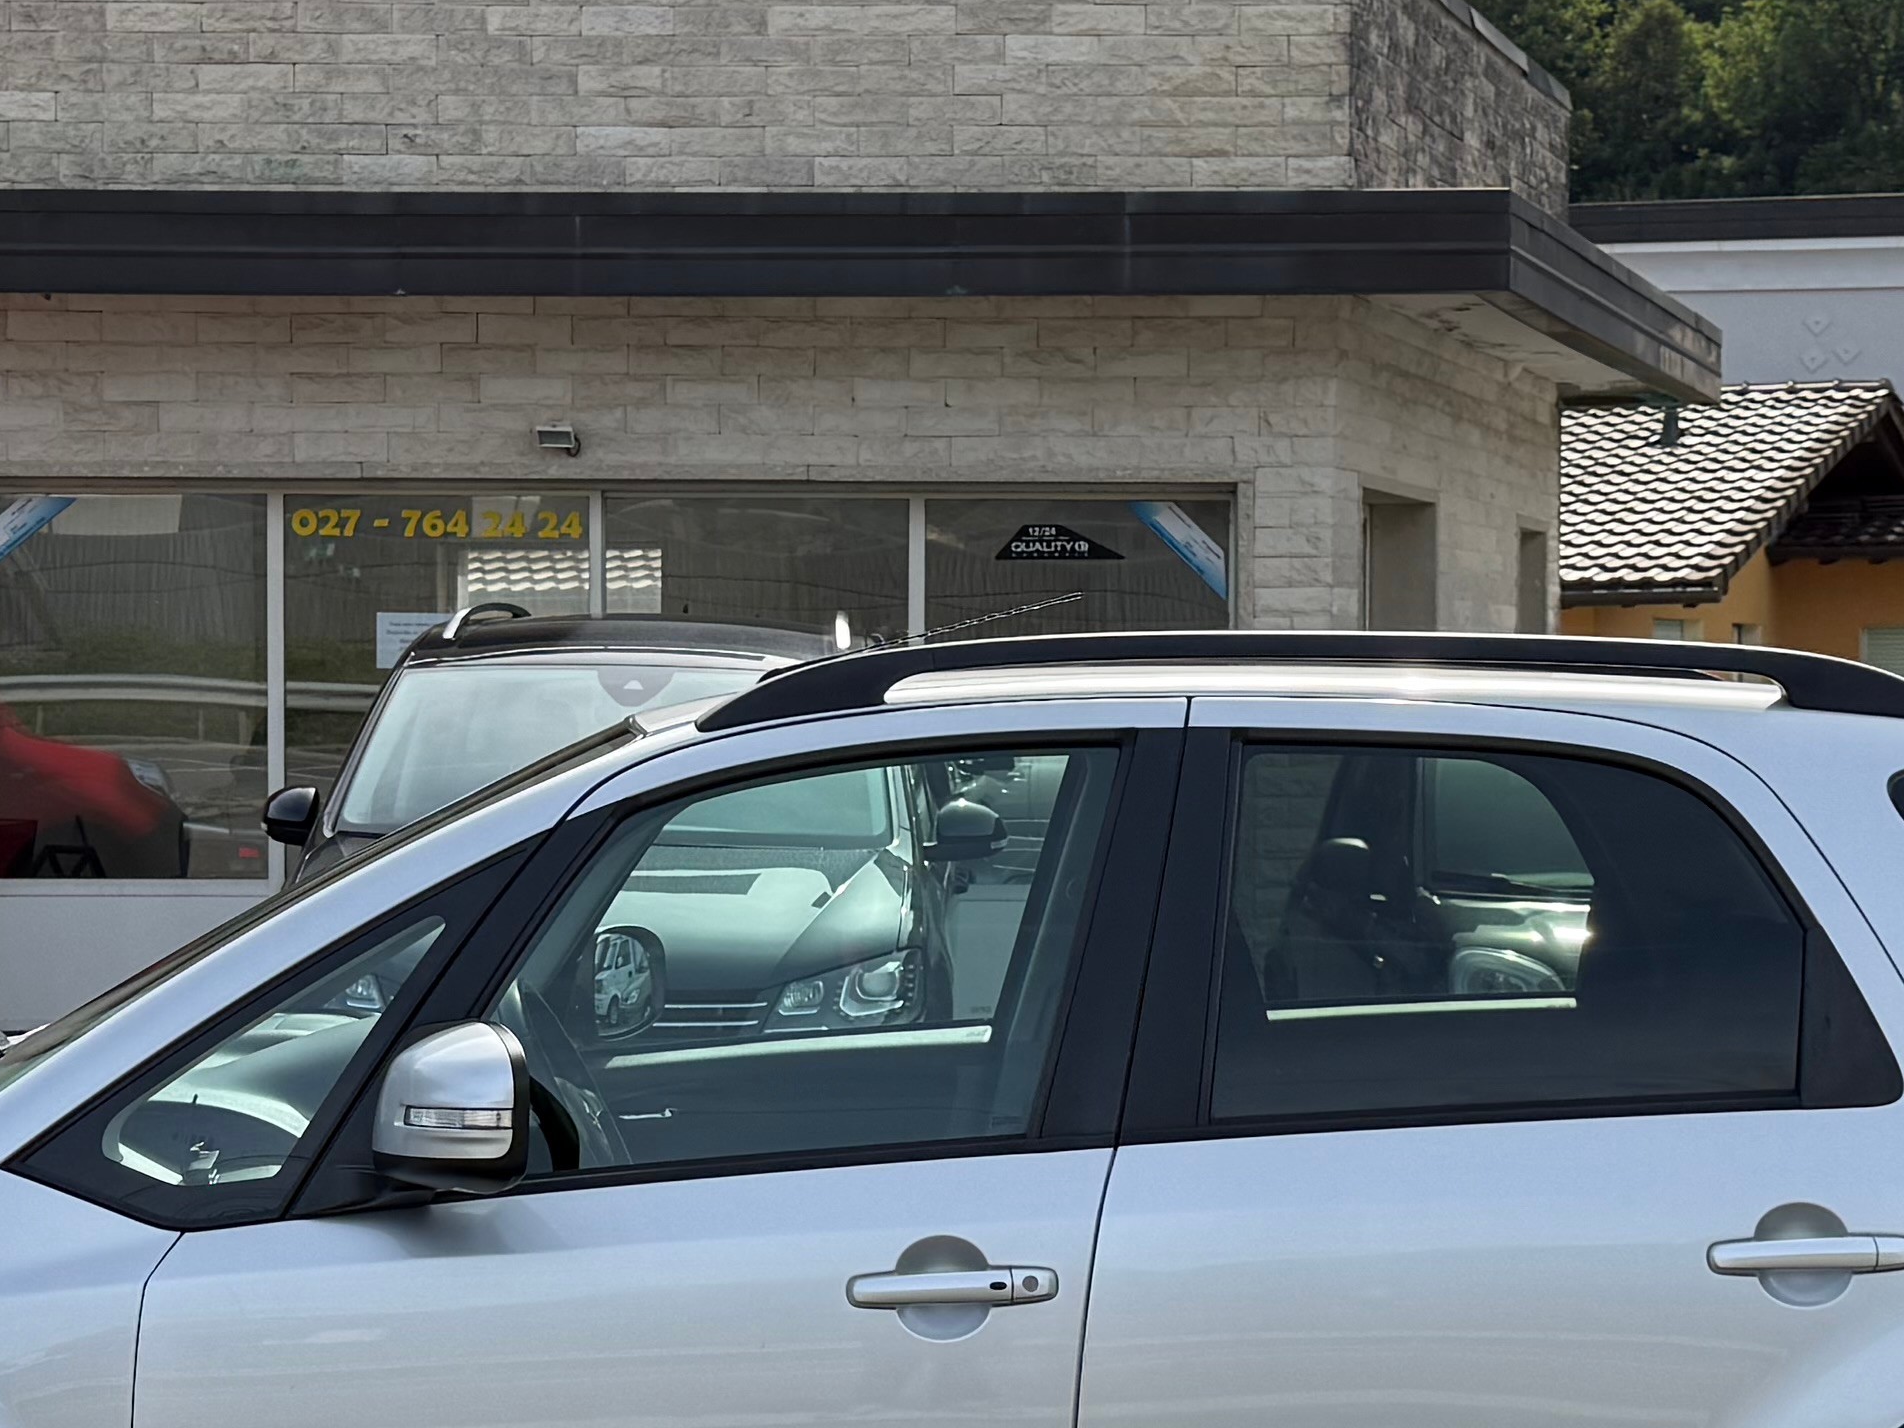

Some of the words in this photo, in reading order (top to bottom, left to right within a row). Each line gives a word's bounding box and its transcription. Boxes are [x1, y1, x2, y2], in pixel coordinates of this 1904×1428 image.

[291, 509, 361, 537] 027
[401, 509, 469, 538] 764
[482, 511, 528, 538] 24
[537, 511, 583, 539] 24
